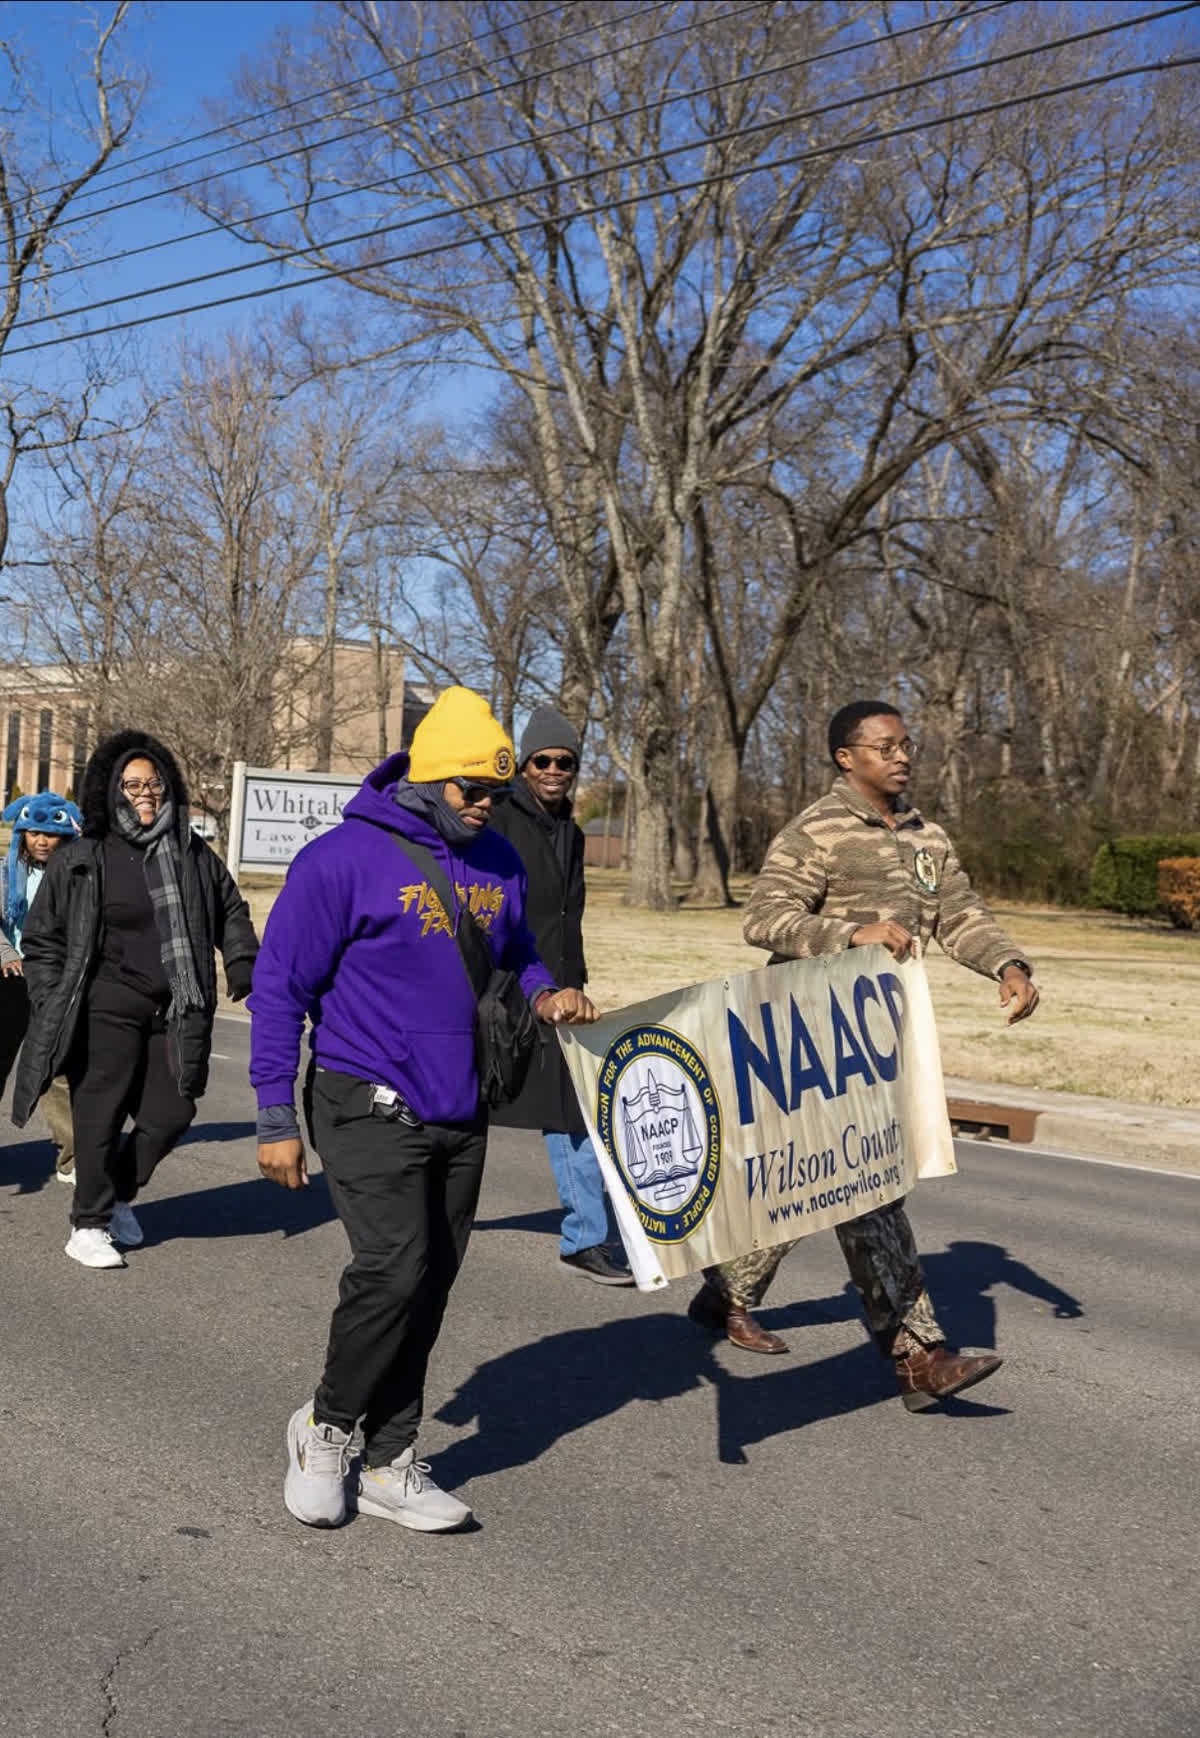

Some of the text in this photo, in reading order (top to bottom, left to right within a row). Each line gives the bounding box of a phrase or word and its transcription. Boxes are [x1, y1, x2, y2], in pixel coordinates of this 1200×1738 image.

[256, 830, 295, 841] Law
[615, 1039, 634, 1060] THE
[638, 1033, 706, 1082] ADVANCEMENT
[727, 972, 908, 1126] NAACP
[603, 1060, 618, 1088] FOR
[703, 1088, 715, 1105] OF
[641, 1118, 678, 1141] NAACP
[655, 1150, 673, 1165] 1909
[707, 1115, 719, 1182] COLORED
[744, 1141, 837, 1200] Wilson
[682, 1185, 710, 1228] PEOPLE
[768, 1165, 900, 1224] www.naacpwilco.org
